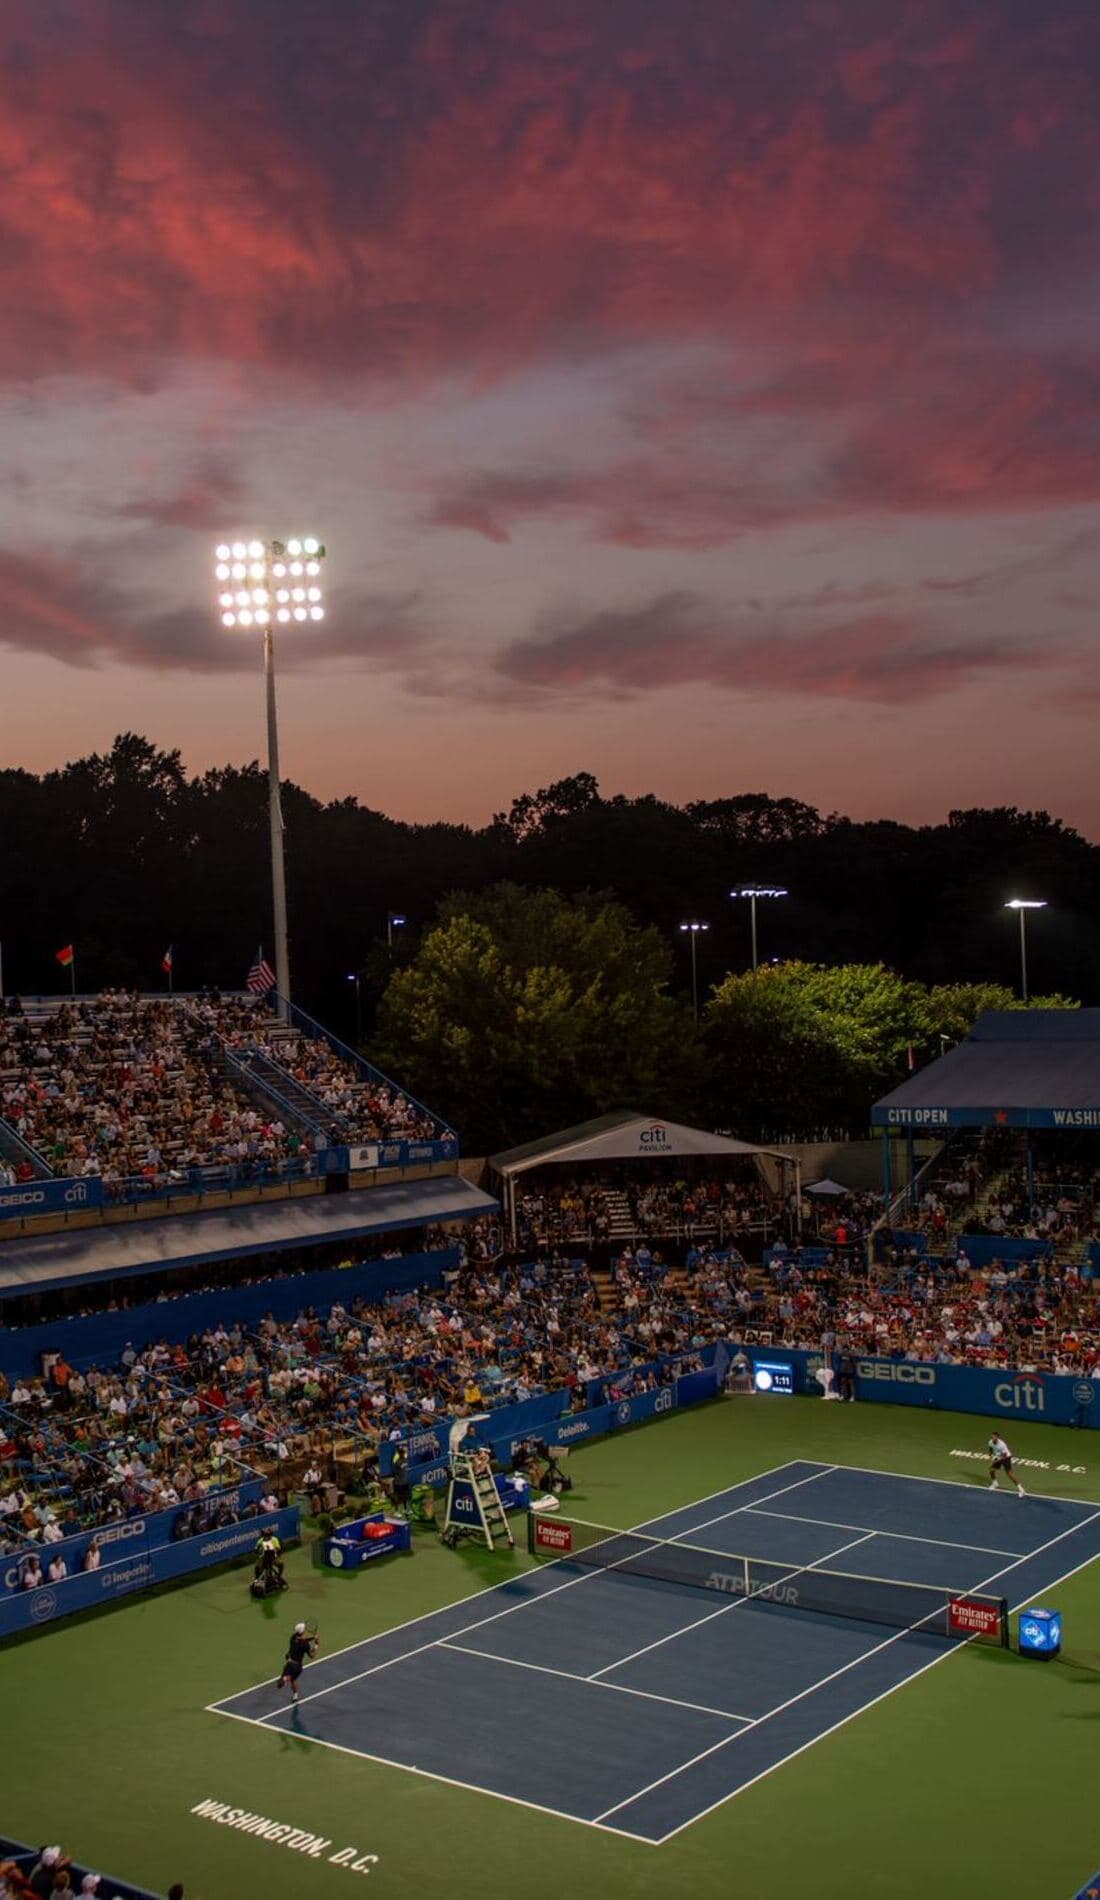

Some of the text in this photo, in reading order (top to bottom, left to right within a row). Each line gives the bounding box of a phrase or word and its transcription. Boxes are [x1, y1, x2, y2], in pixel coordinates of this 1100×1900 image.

[888, 1108, 948, 1123] CITI OPEN
[640, 1124, 666, 1142] citi
[64, 1182, 87, 1202] citi
[774, 1375, 790, 1385] 1:11
[857, 1361, 936, 1385] GEICO
[655, 1387, 671, 1412] citi
[994, 1373, 1046, 1411] citi
[1056, 1464, 1087, 1474] D.C.
[455, 1495, 474, 1512] citi
[92, 1520, 146, 1546] GEICO
[751, 1579, 800, 1605] TOUR
[951, 1602, 996, 1622] Emirates
[328, 1847, 379, 1874] D.C.
